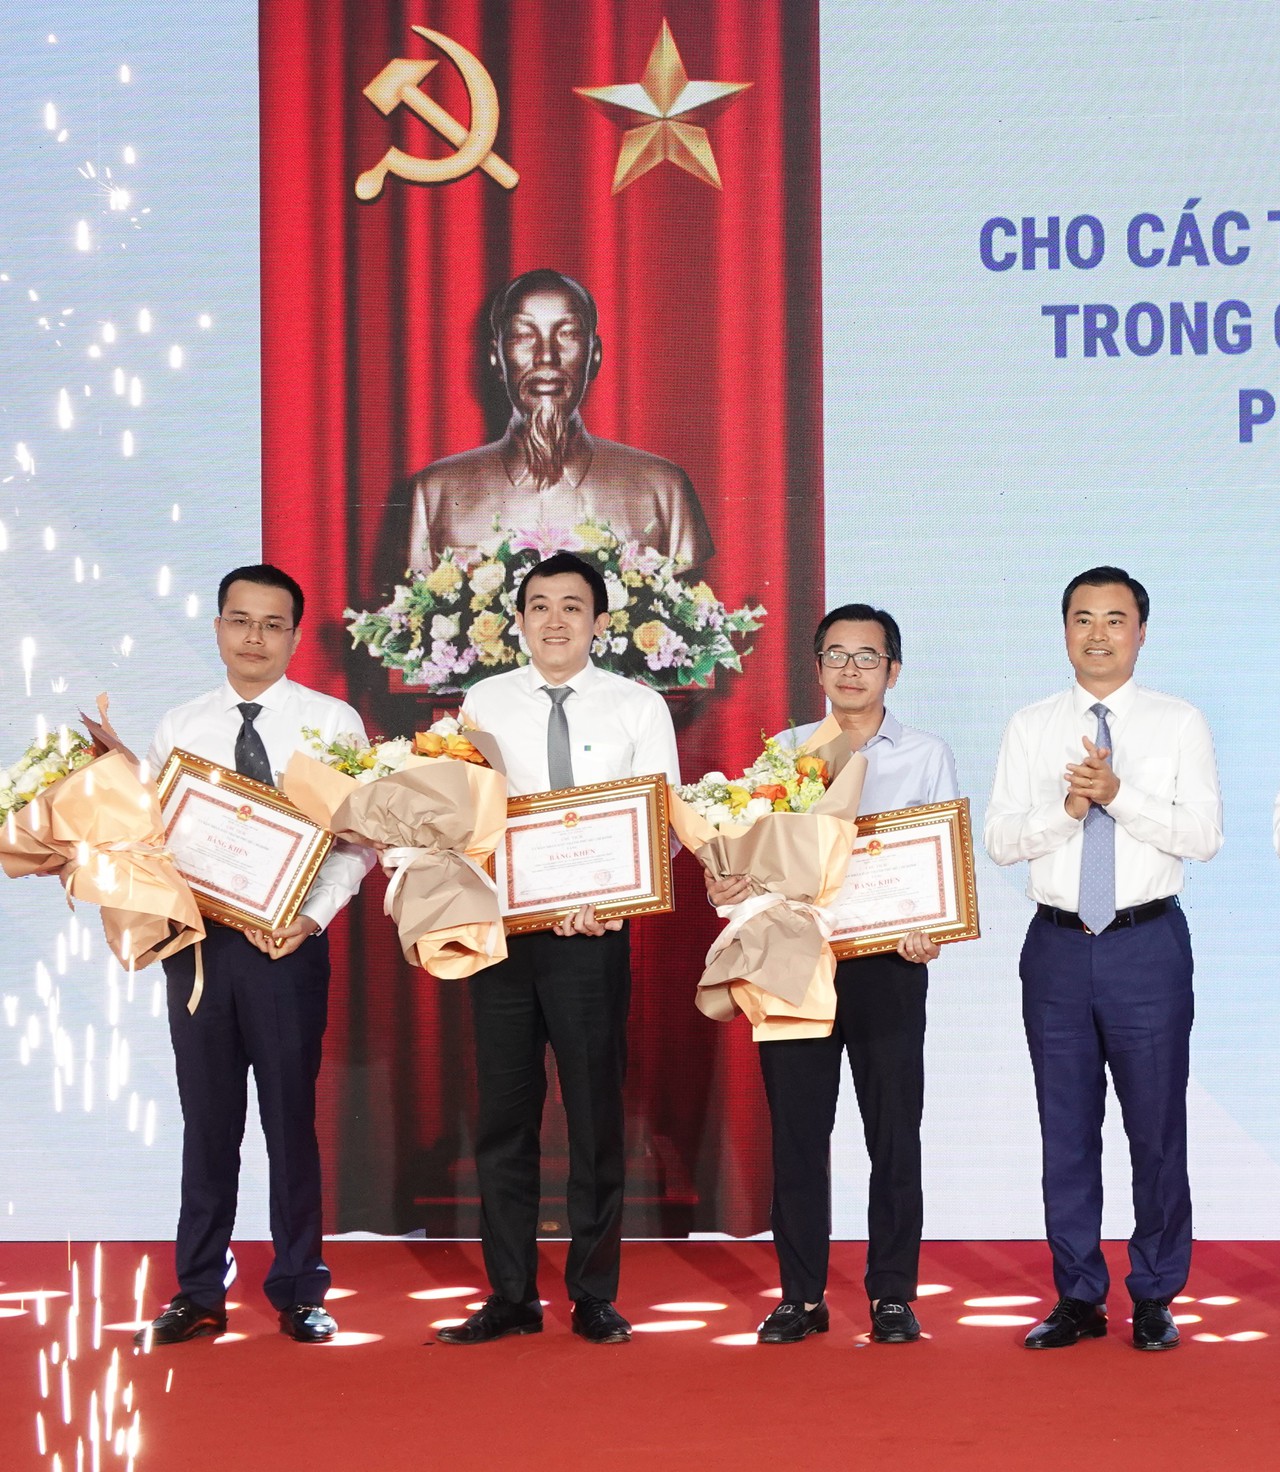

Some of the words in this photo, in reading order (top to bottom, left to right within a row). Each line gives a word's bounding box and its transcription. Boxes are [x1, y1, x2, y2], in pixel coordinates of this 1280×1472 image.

[979, 214, 1105, 272] CHO
[1127, 197, 1250, 269] CÁC
[1041, 299, 1252, 359] TRONG
